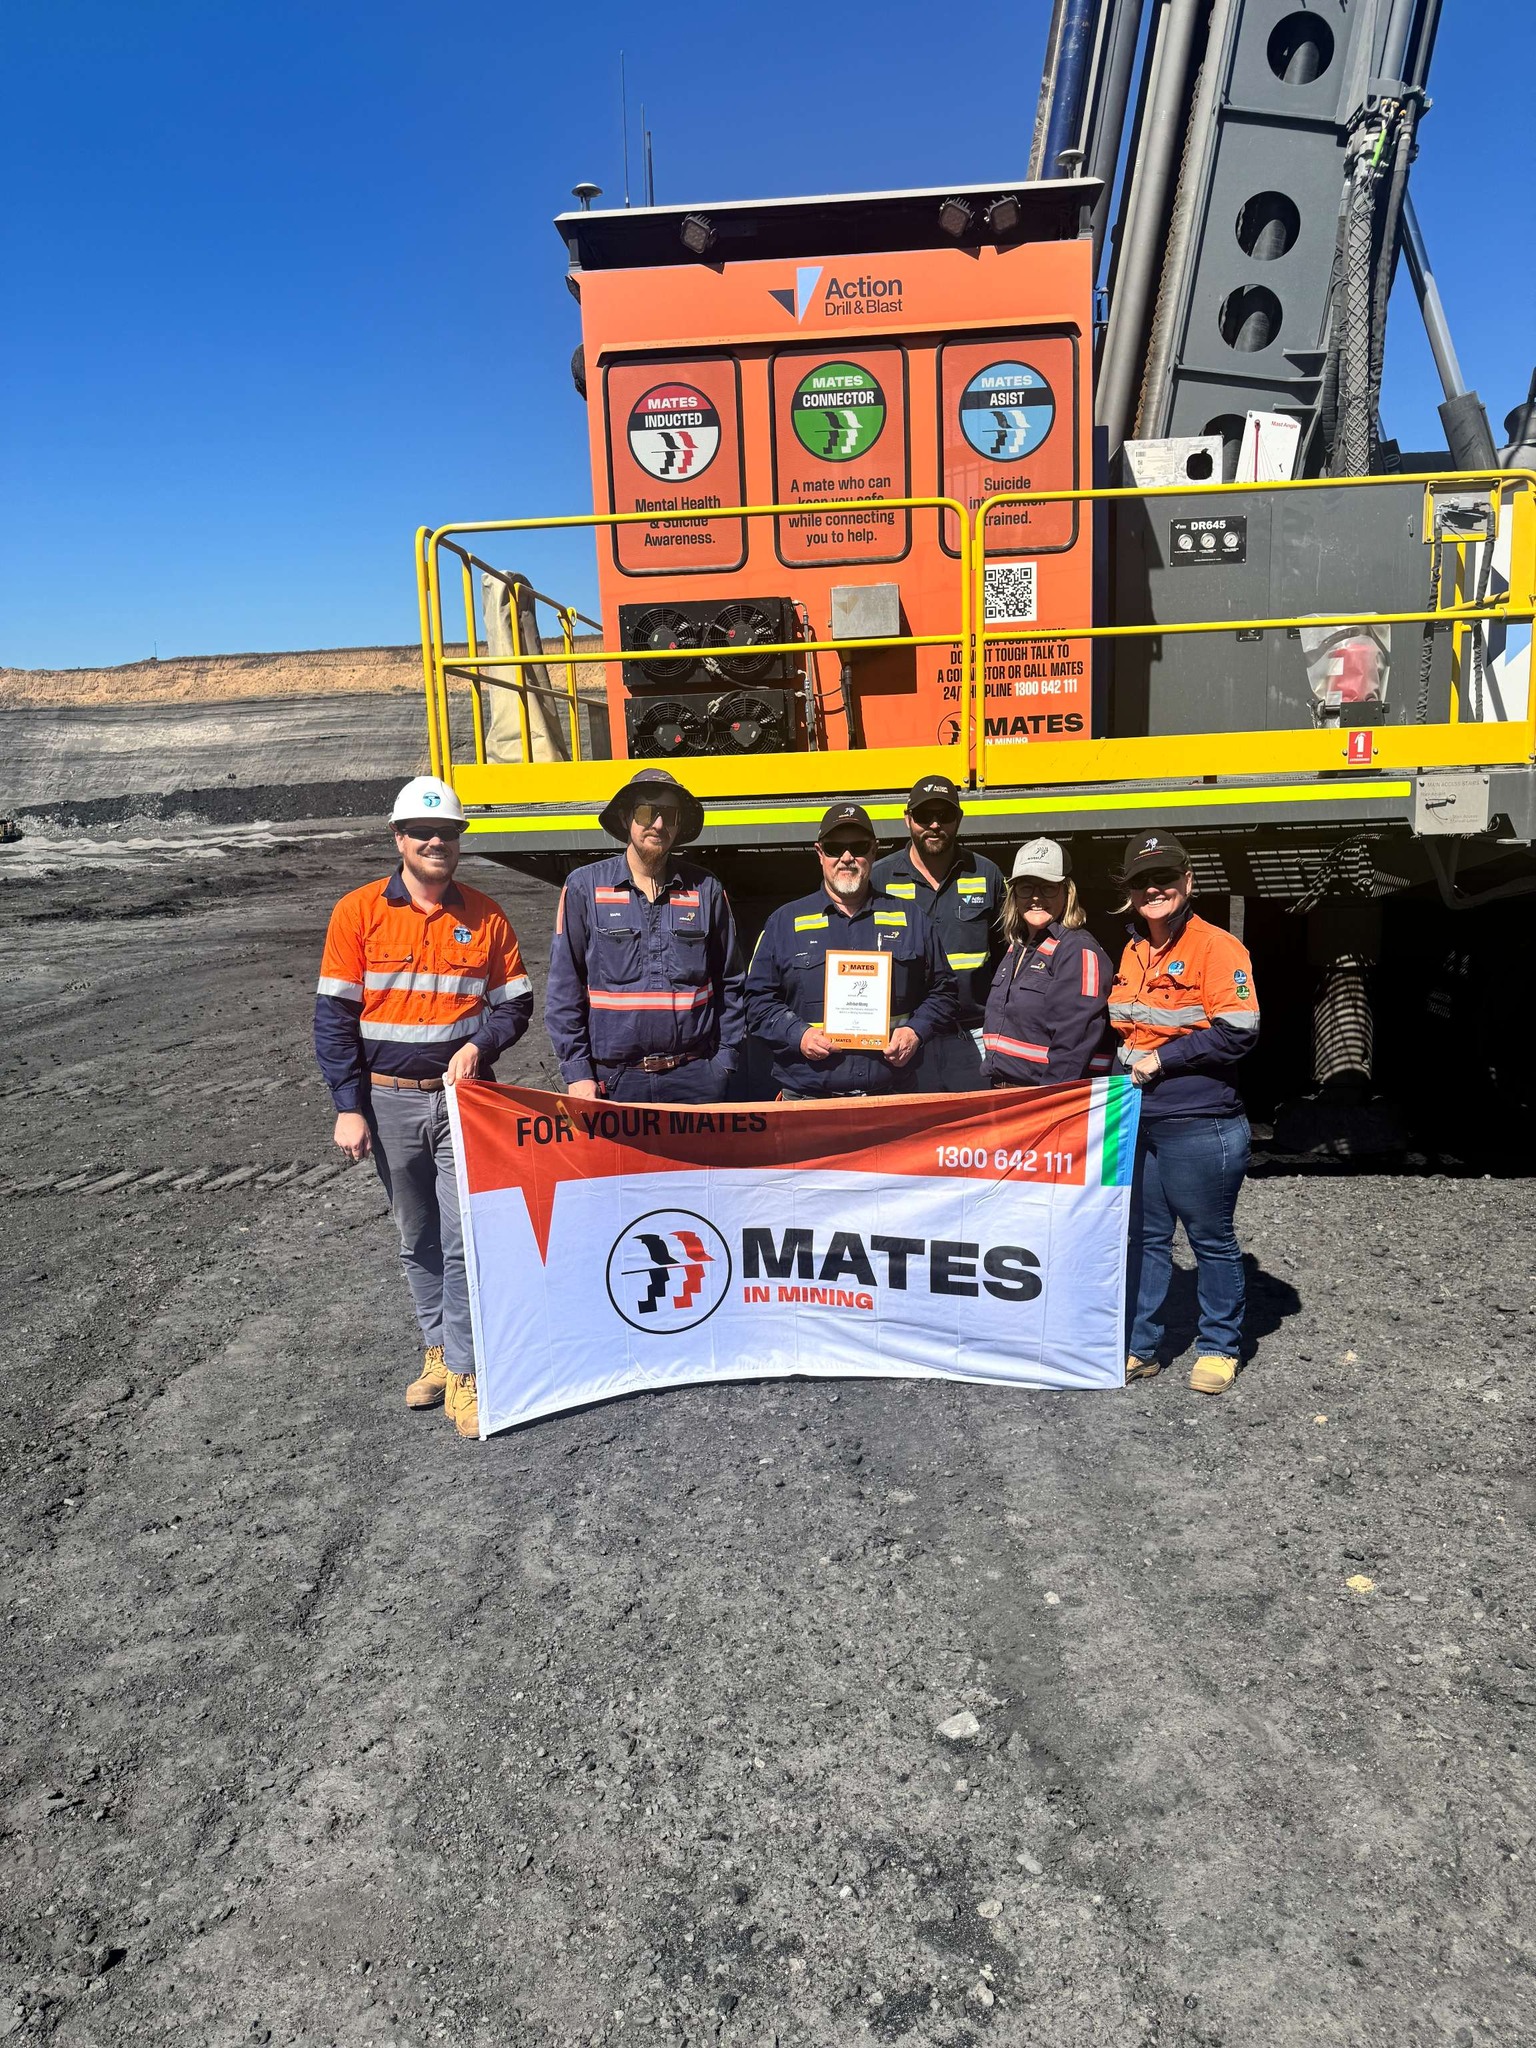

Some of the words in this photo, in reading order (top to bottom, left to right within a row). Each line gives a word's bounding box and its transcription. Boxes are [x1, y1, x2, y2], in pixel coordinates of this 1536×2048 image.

[825, 275, 903, 300] Action
[825, 301, 852, 316] Drill
[853, 300, 865, 315] &
[866, 298, 903, 314] Blast
[812, 375, 864, 389] MATES
[981, 375, 1033, 388] MATES
[647, 396, 698, 410] MATES
[802, 390, 875, 408] CONNECTOR
[989, 391, 1025, 406] ASIST
[644, 412, 703, 428] INDUCTED
[790, 478, 800, 493] A
[803, 478, 835, 493] mate
[838, 476, 865, 491] who
[868, 476, 891, 489] can
[984, 475, 1031, 491] Suicide
[635, 496, 678, 513] Mental
[681, 494, 721, 511] Health
[788, 513, 822, 528] while
[825, 510, 895, 526] connecting
[984, 510, 1032, 527] trained.
[1190, 520, 1227, 531] DR645
[644, 532, 716, 547] Awareness.
[806, 533, 828, 547] you
[831, 530, 844, 543] to
[847, 528, 878, 544] help.
[950, 649, 979, 665] DON
[995, 646, 1028, 662] TOUGH
[1031, 644, 1055, 660] TALK
[1056, 643, 1070, 659] TO
[937, 669, 944, 683] A
[946, 665, 1006, 683] CONTOR
[1008, 664, 1021, 679] OR
[1023, 663, 1048, 679] CALL
[1050, 661, 1084, 677] MATES
[970, 683, 1012, 699] HPLINE
[1014, 681, 1039, 697] 1300
[1040, 679, 1061, 695] 642
[1063, 678, 1078, 694] 111
[984, 712, 1084, 737] MATES
[994, 736, 1029, 745] MINING
[516, 1115, 574, 1147] FOR
[581, 1109, 661, 1140] YOUR
[669, 1111, 768, 1135] MATES
[935, 1145, 988, 1169] 1300
[994, 1149, 1038, 1172] 642
[1043, 1151, 1073, 1174] 111
[742, 1227, 1043, 1302] MATES
[743, 1286, 770, 1303] IN
[777, 1286, 874, 1310] MINING
